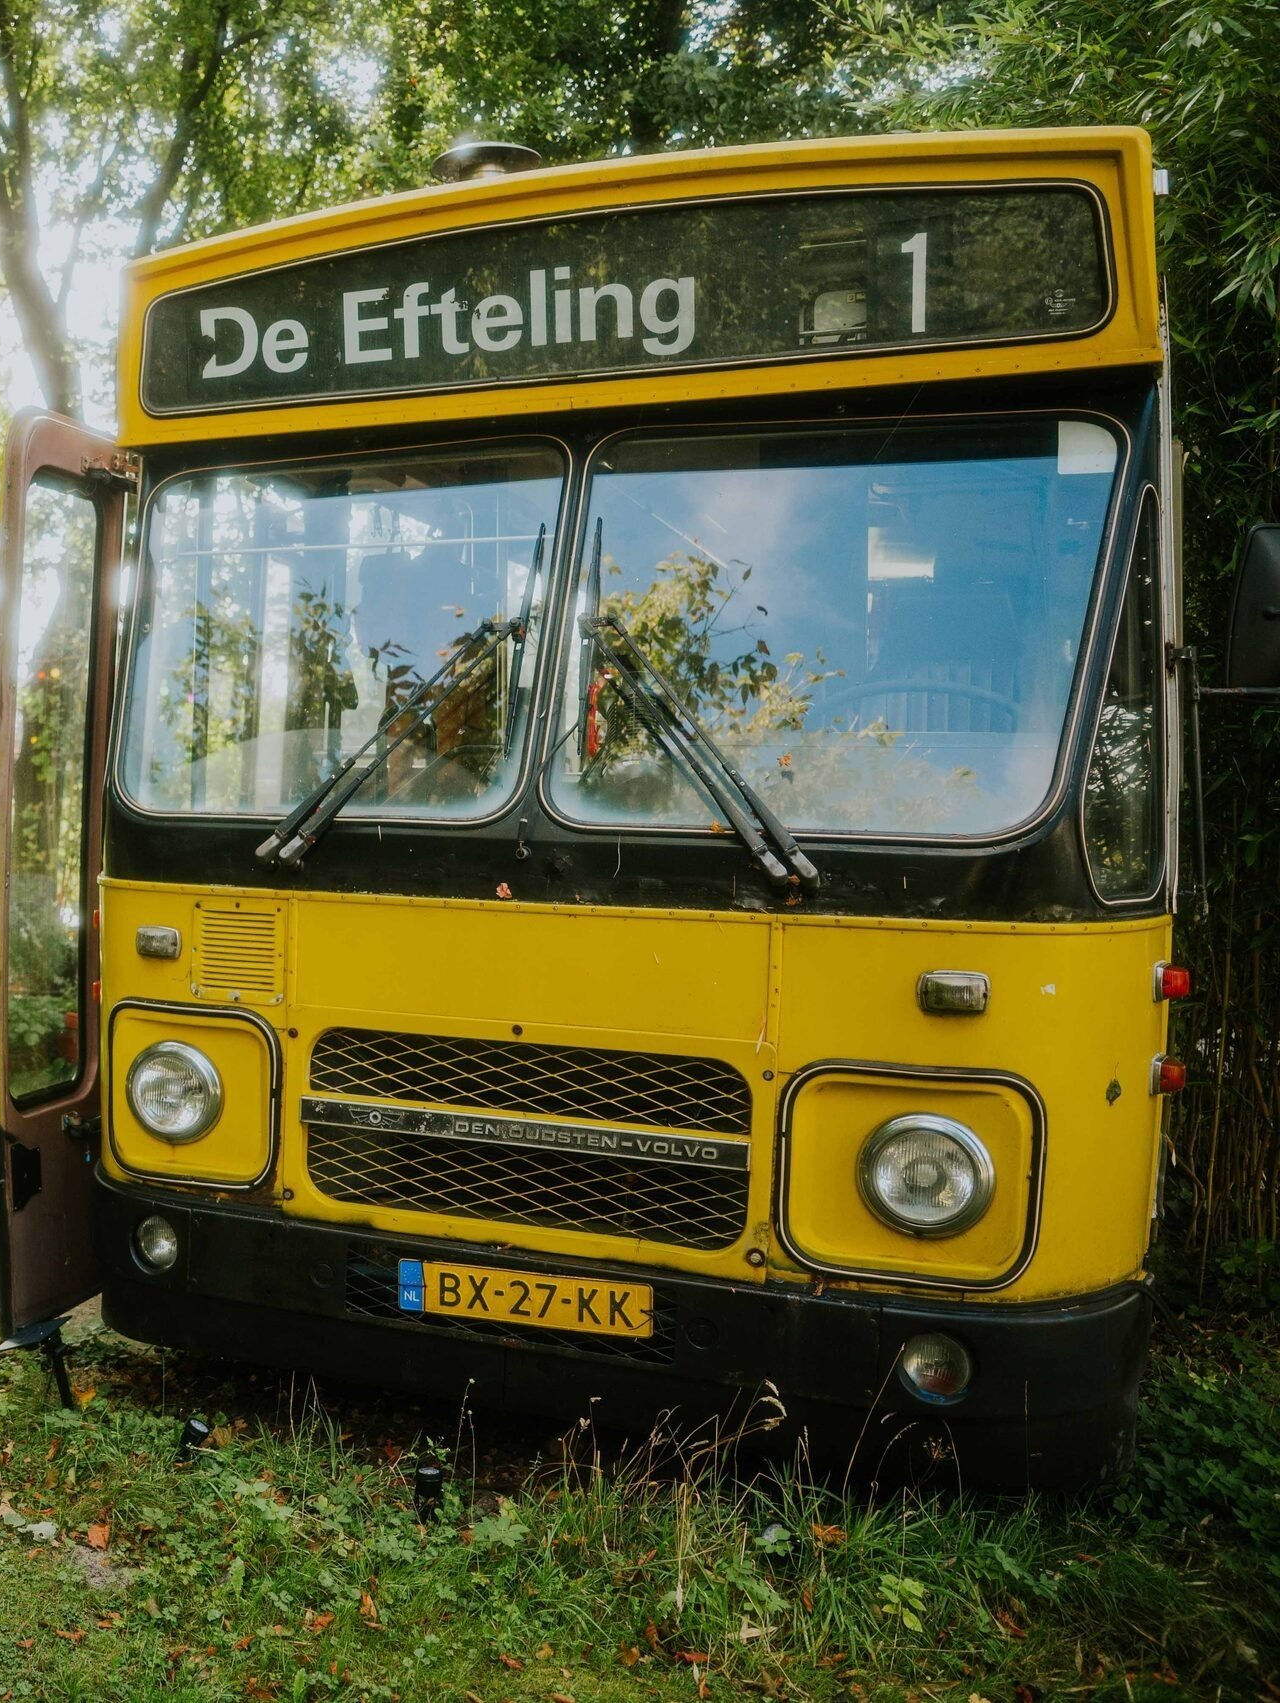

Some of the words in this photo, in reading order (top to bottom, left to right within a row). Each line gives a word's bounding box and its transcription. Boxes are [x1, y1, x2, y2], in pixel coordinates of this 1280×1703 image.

[901, 232, 928, 333] 1
[200, 306, 309, 379] De
[342, 266, 696, 364] Efteling
[455, 1120, 500, 1136] DEN
[508, 1124, 718, 1160] OUDSTEN-VOLVO
[403, 1291, 420, 1302] NL
[439, 1272, 634, 1328] BX-27-KK
